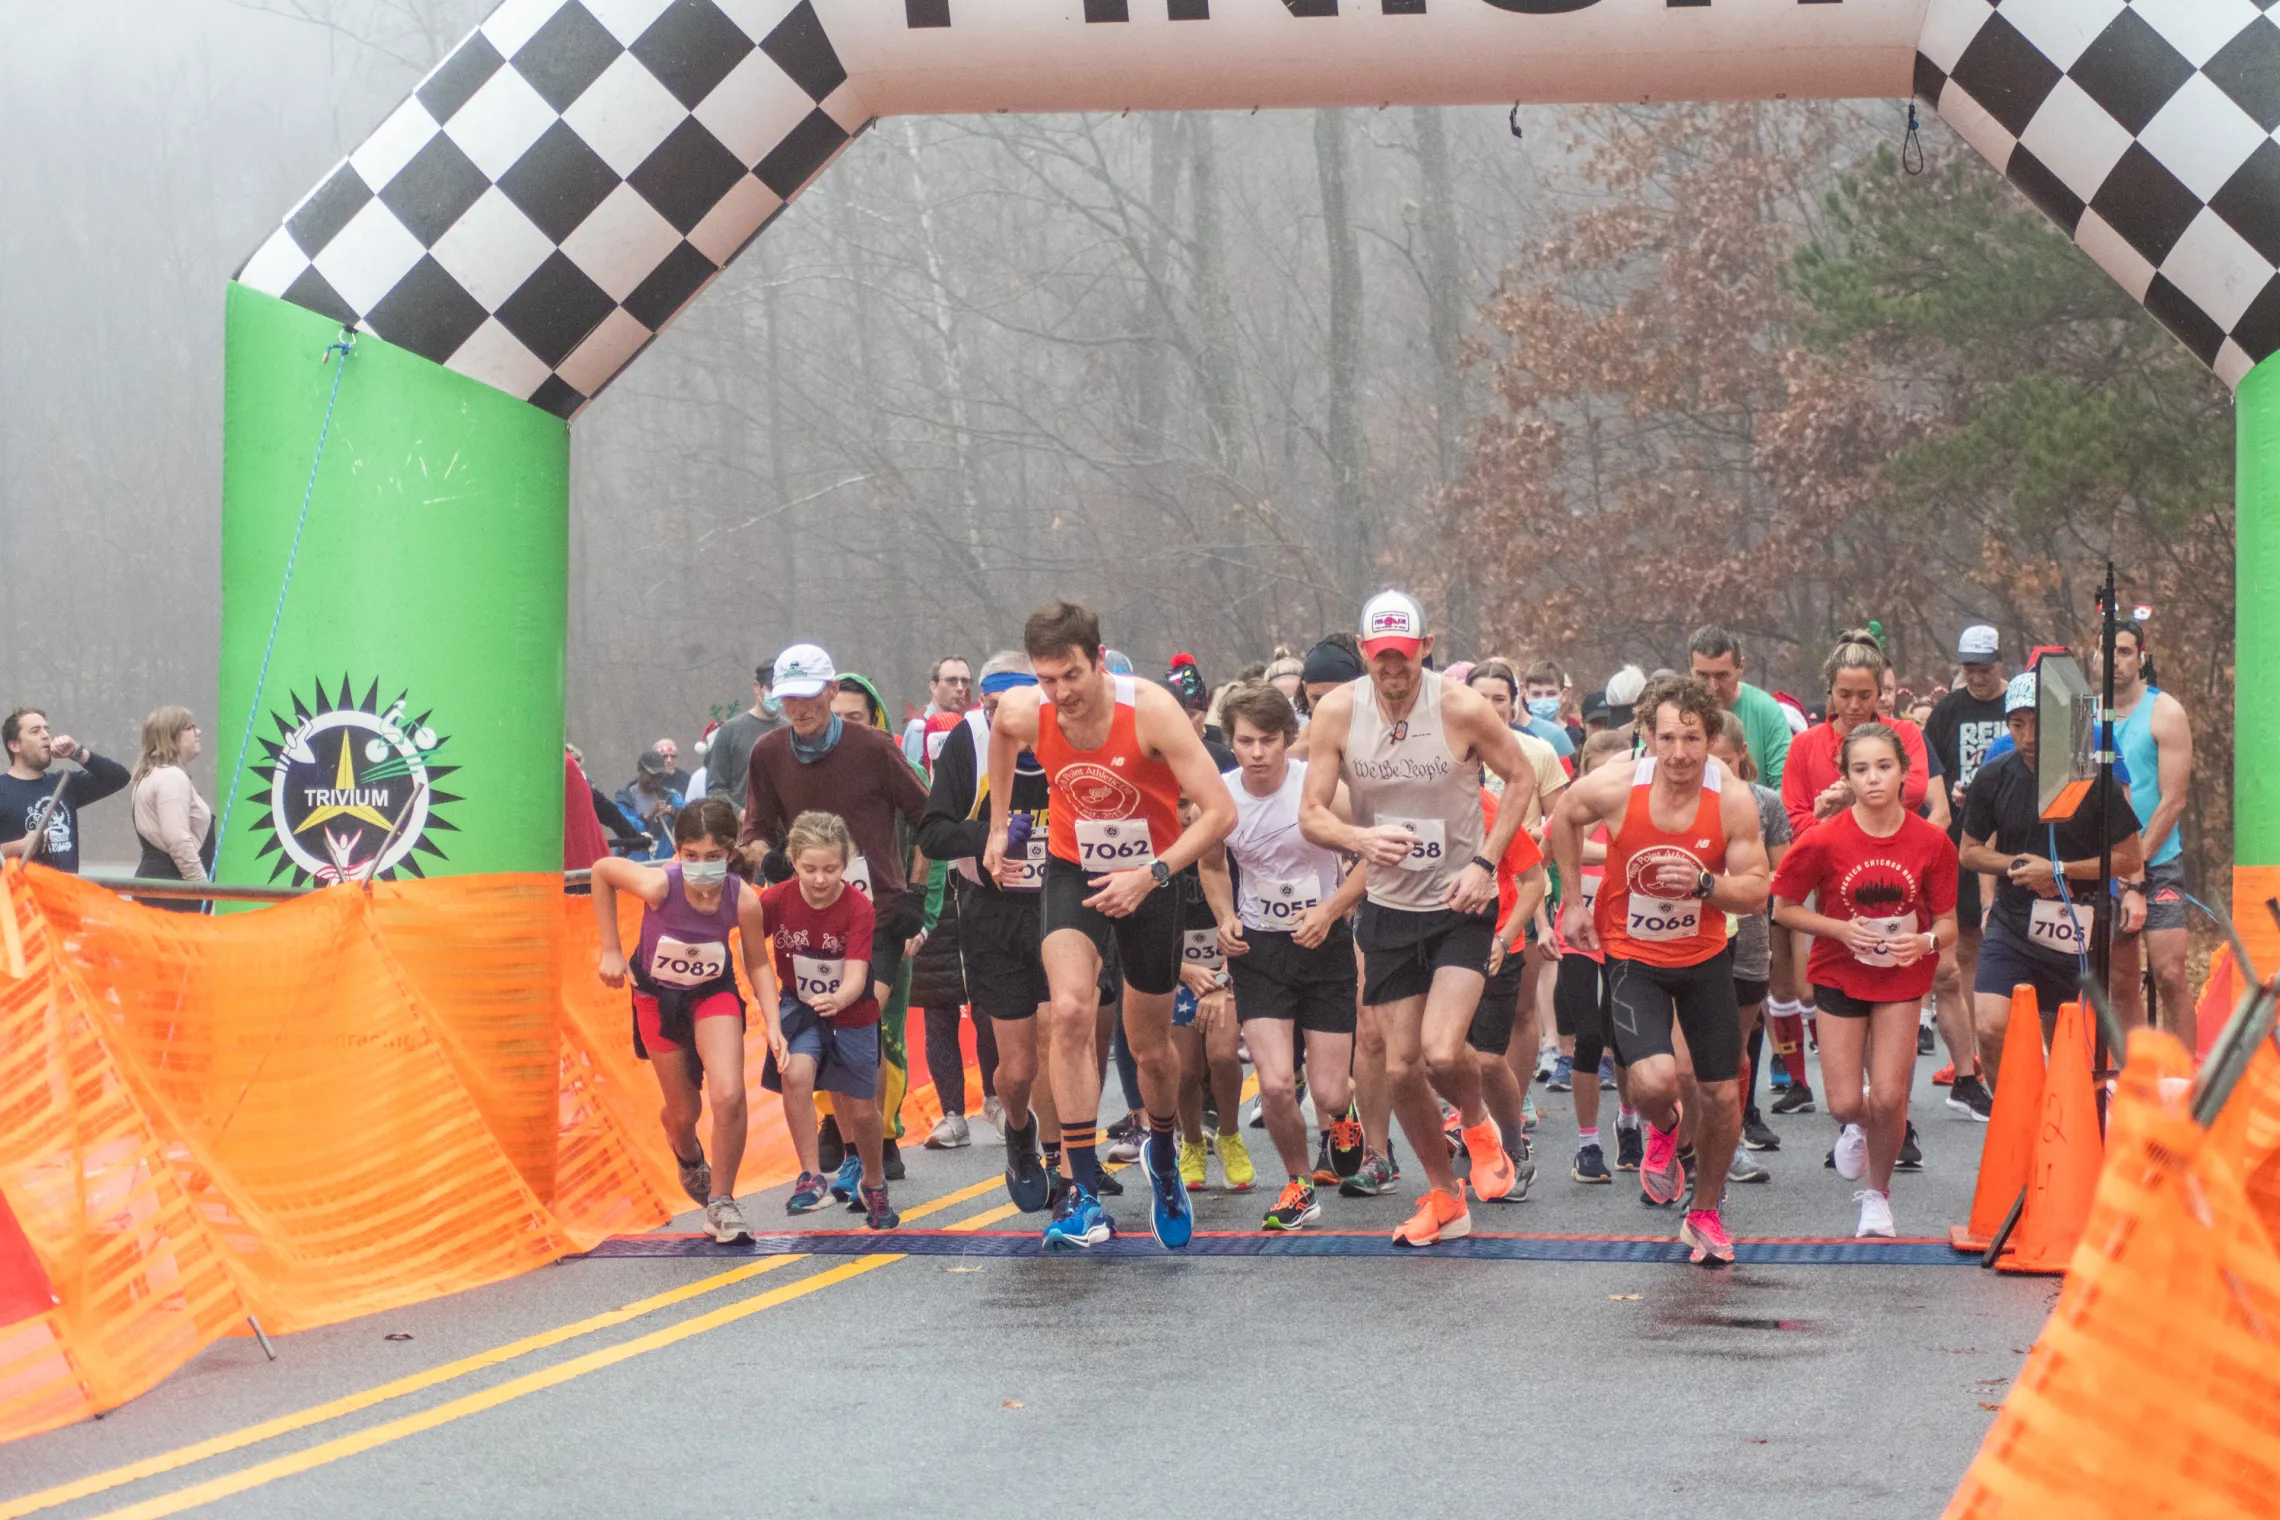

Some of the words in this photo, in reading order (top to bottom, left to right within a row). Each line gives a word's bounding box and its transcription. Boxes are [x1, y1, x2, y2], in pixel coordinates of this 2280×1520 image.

[1062, 769, 1084, 782] Point
[1399, 755, 1451, 783] People
[304, 788, 389, 807] TRIVIUM
[1080, 840, 1150, 860] 7062
[1636, 851, 1661, 865] Point
[1864, 859, 1902, 871] CHICAGO
[1630, 913, 1697, 931] 7068
[2034, 920, 2086, 942] 7105
[657, 955, 721, 976] 7082
